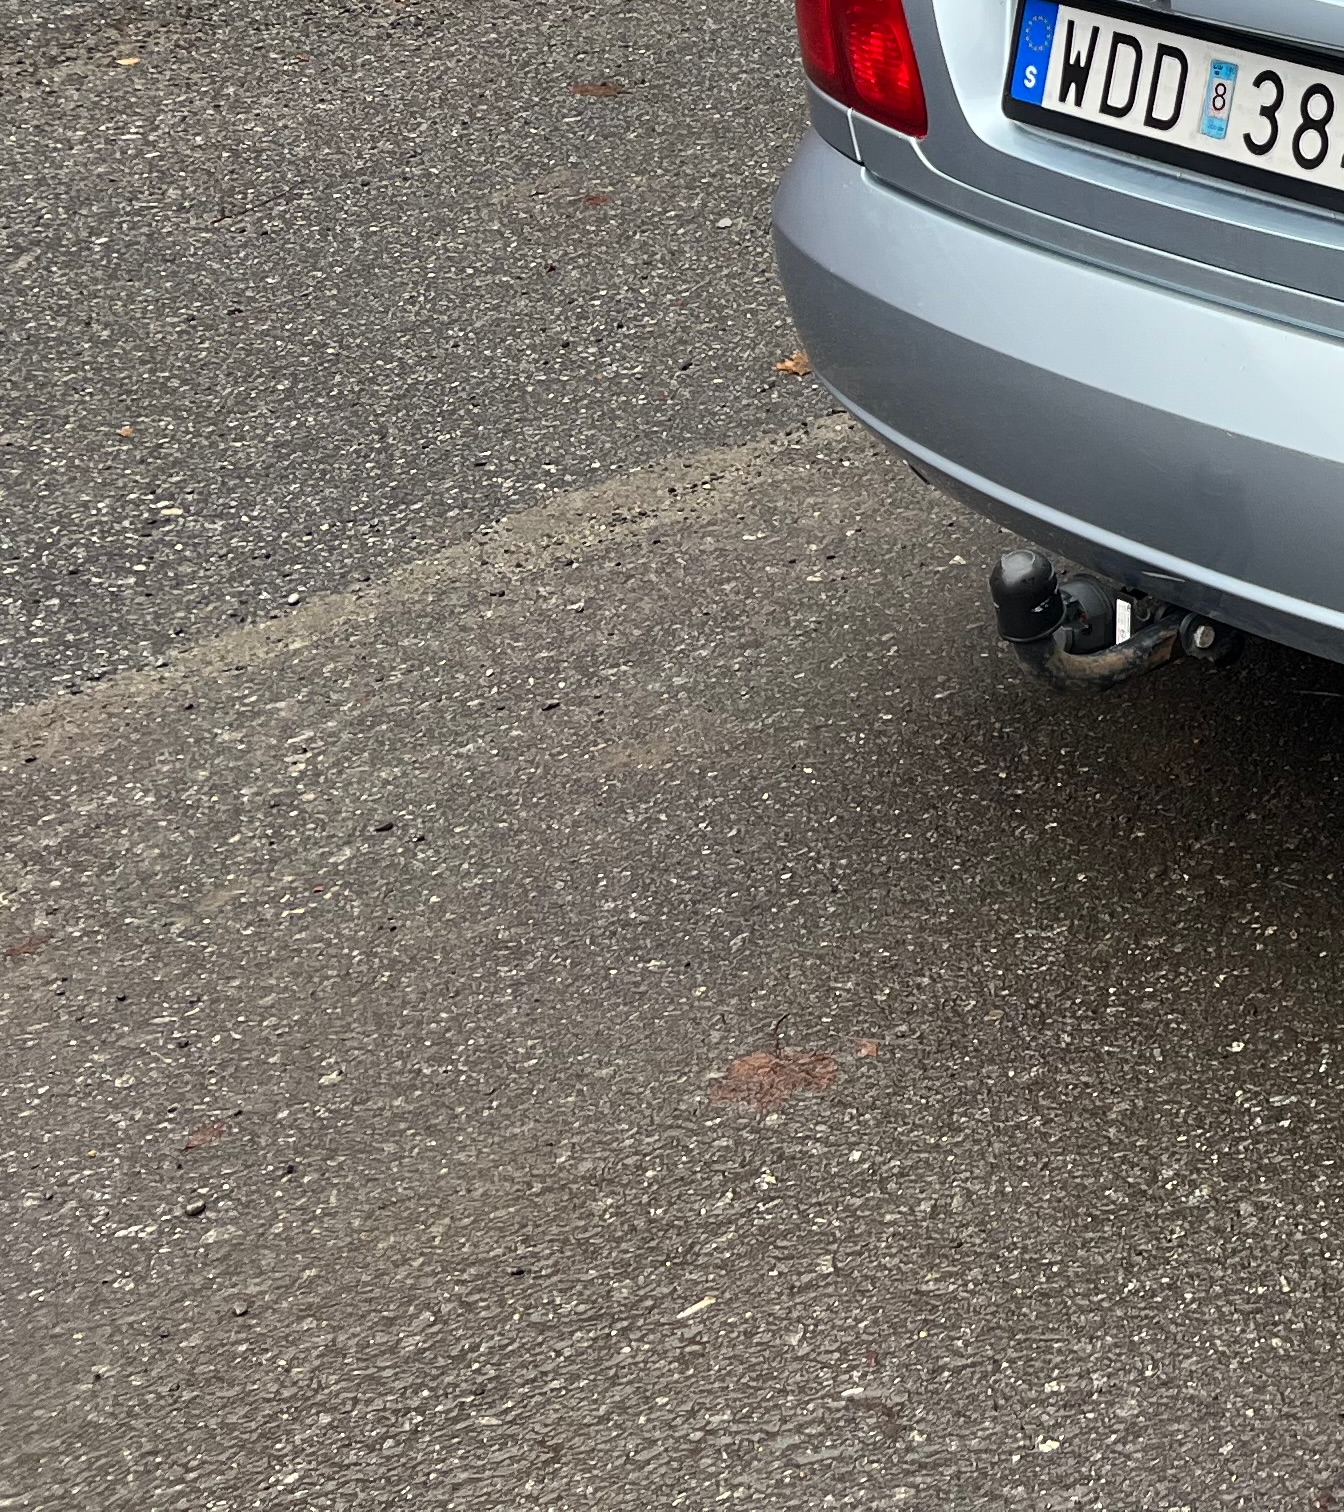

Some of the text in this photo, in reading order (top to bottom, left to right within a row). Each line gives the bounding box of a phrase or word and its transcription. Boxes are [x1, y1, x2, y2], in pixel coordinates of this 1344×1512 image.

[1023, 65, 1037, 89] S
[1058, 19, 1189, 131] WDD
[1212, 83, 1227, 110] 8
